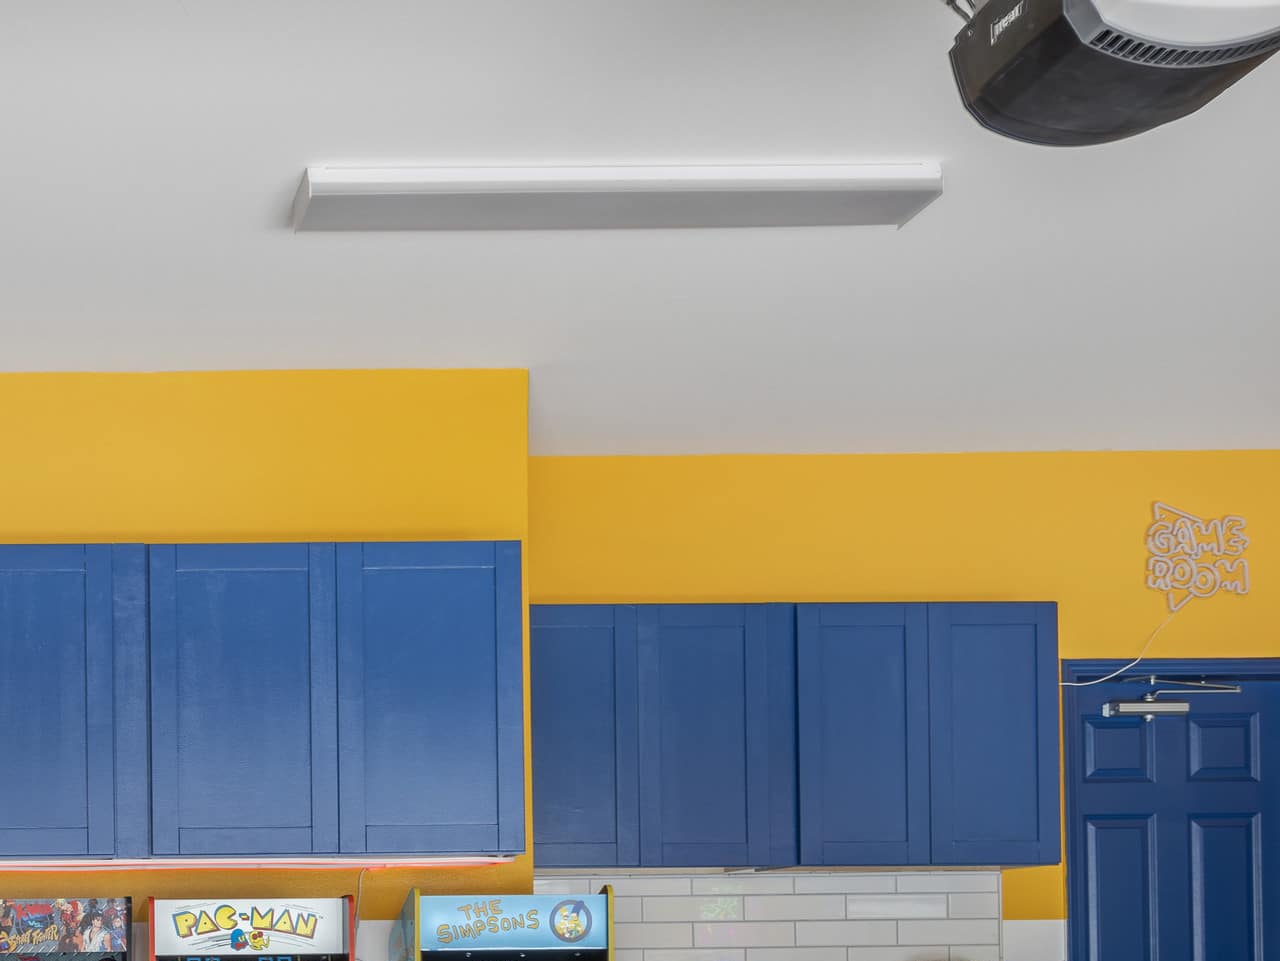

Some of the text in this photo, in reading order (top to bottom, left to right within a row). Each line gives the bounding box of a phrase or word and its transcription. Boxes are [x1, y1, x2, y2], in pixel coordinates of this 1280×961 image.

[1147, 516, 1250, 558] GAME
[1147, 556, 1250, 597] ROOM
[172, 904, 318, 940] PAC-MAN
[436, 909, 540, 943] SIMPSONS
[457, 899, 503, 922] THE
